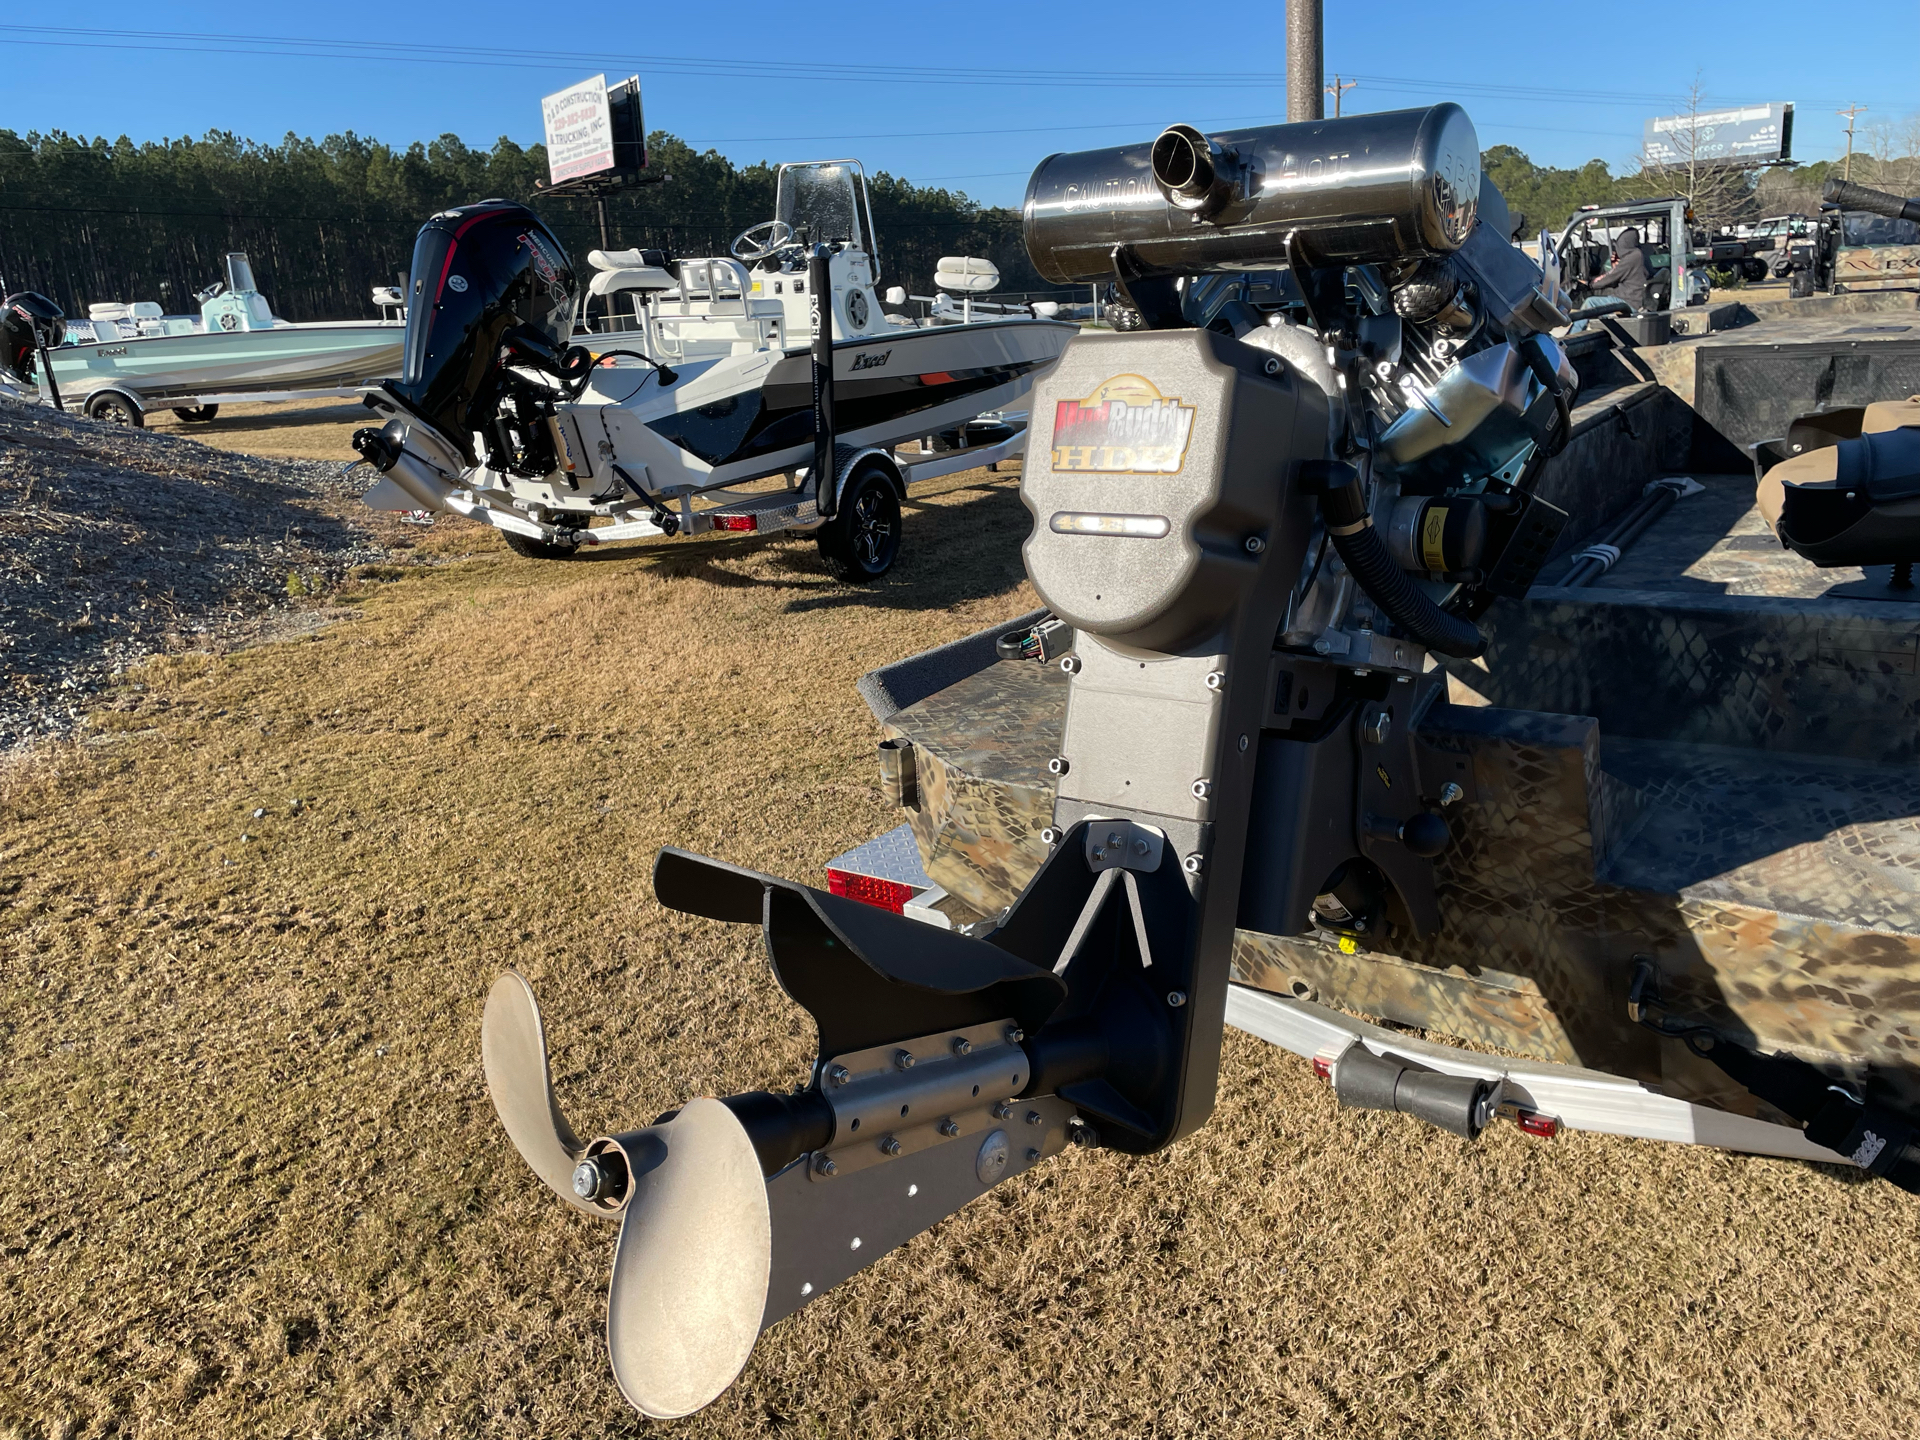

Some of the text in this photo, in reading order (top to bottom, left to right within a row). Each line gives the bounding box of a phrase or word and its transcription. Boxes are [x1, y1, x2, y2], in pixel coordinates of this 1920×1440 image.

[560, 91, 602, 110] CONSTRUCTION
[590, 117, 606, 134] INC.
[1279, 153, 1350, 190] HOT
[1063, 175, 1155, 213] CAUTION
[527, 229, 558, 269] MERCURY
[810, 293, 822, 344] EXCEL
[848, 348, 892, 372] Excel
